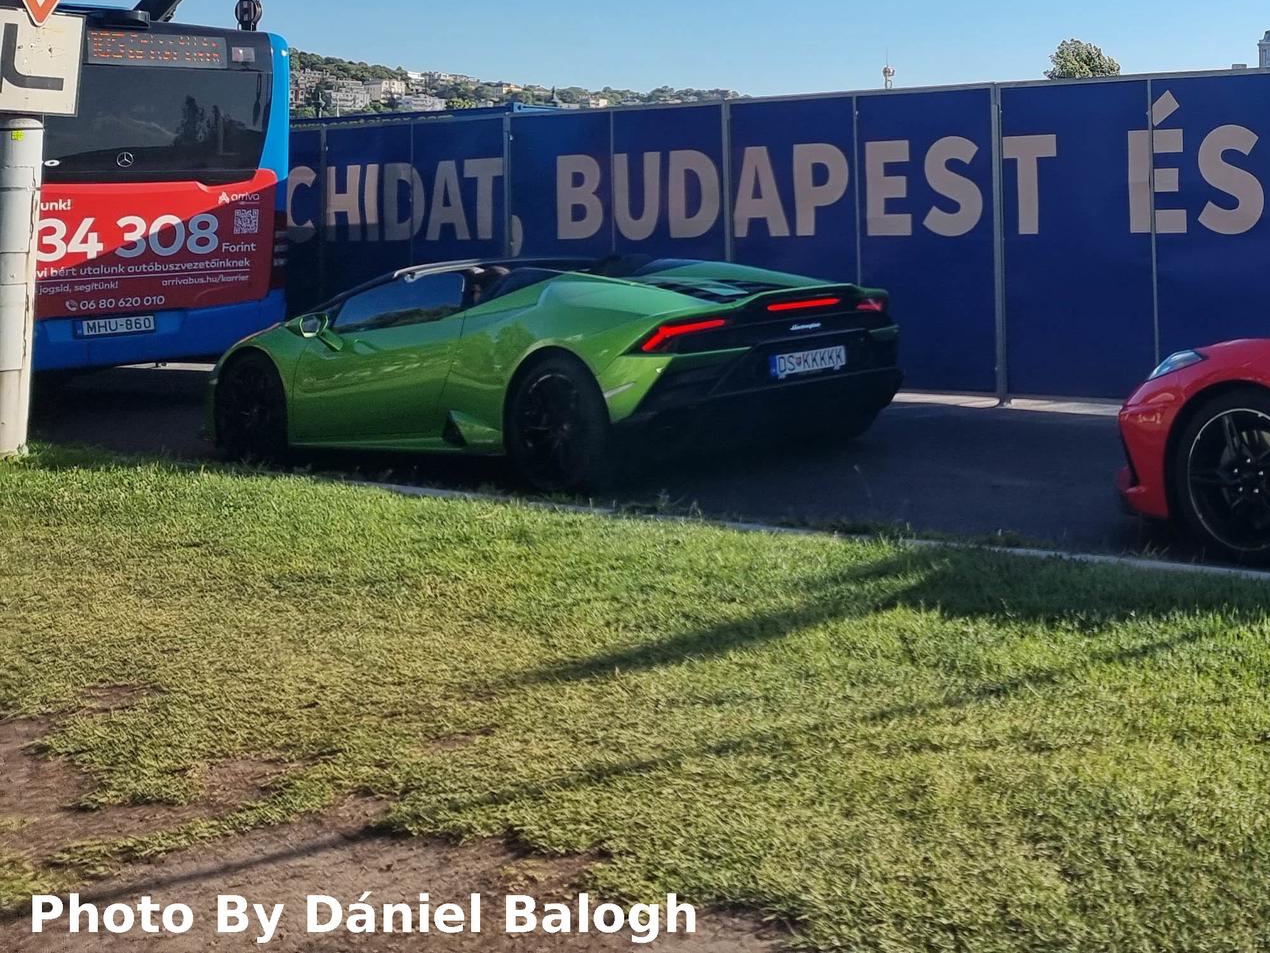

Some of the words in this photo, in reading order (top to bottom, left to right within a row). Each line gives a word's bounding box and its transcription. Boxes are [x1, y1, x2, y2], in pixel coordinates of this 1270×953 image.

[555, 134, 1057, 240] BUDAPEST
[1128, 90, 1265, 235] ÉS
[231, 192, 260, 202] arriva
[36, 217, 104, 262] 34
[114, 213, 219, 258] 308
[222, 241, 257, 253] Forint
[50, 266, 77, 277] bért
[80, 264, 125, 276] utalunk
[127, 258, 250, 274] autóbuszvezetőinknek
[161, 274, 250, 287] arrivabus.hu/karrier
[80, 300, 96, 310] 06
[98, 298, 116, 309] 80
[118, 297, 141, 308] 620
[143, 295, 165, 306] 010
[86, 317, 152, 334] MHU-860
